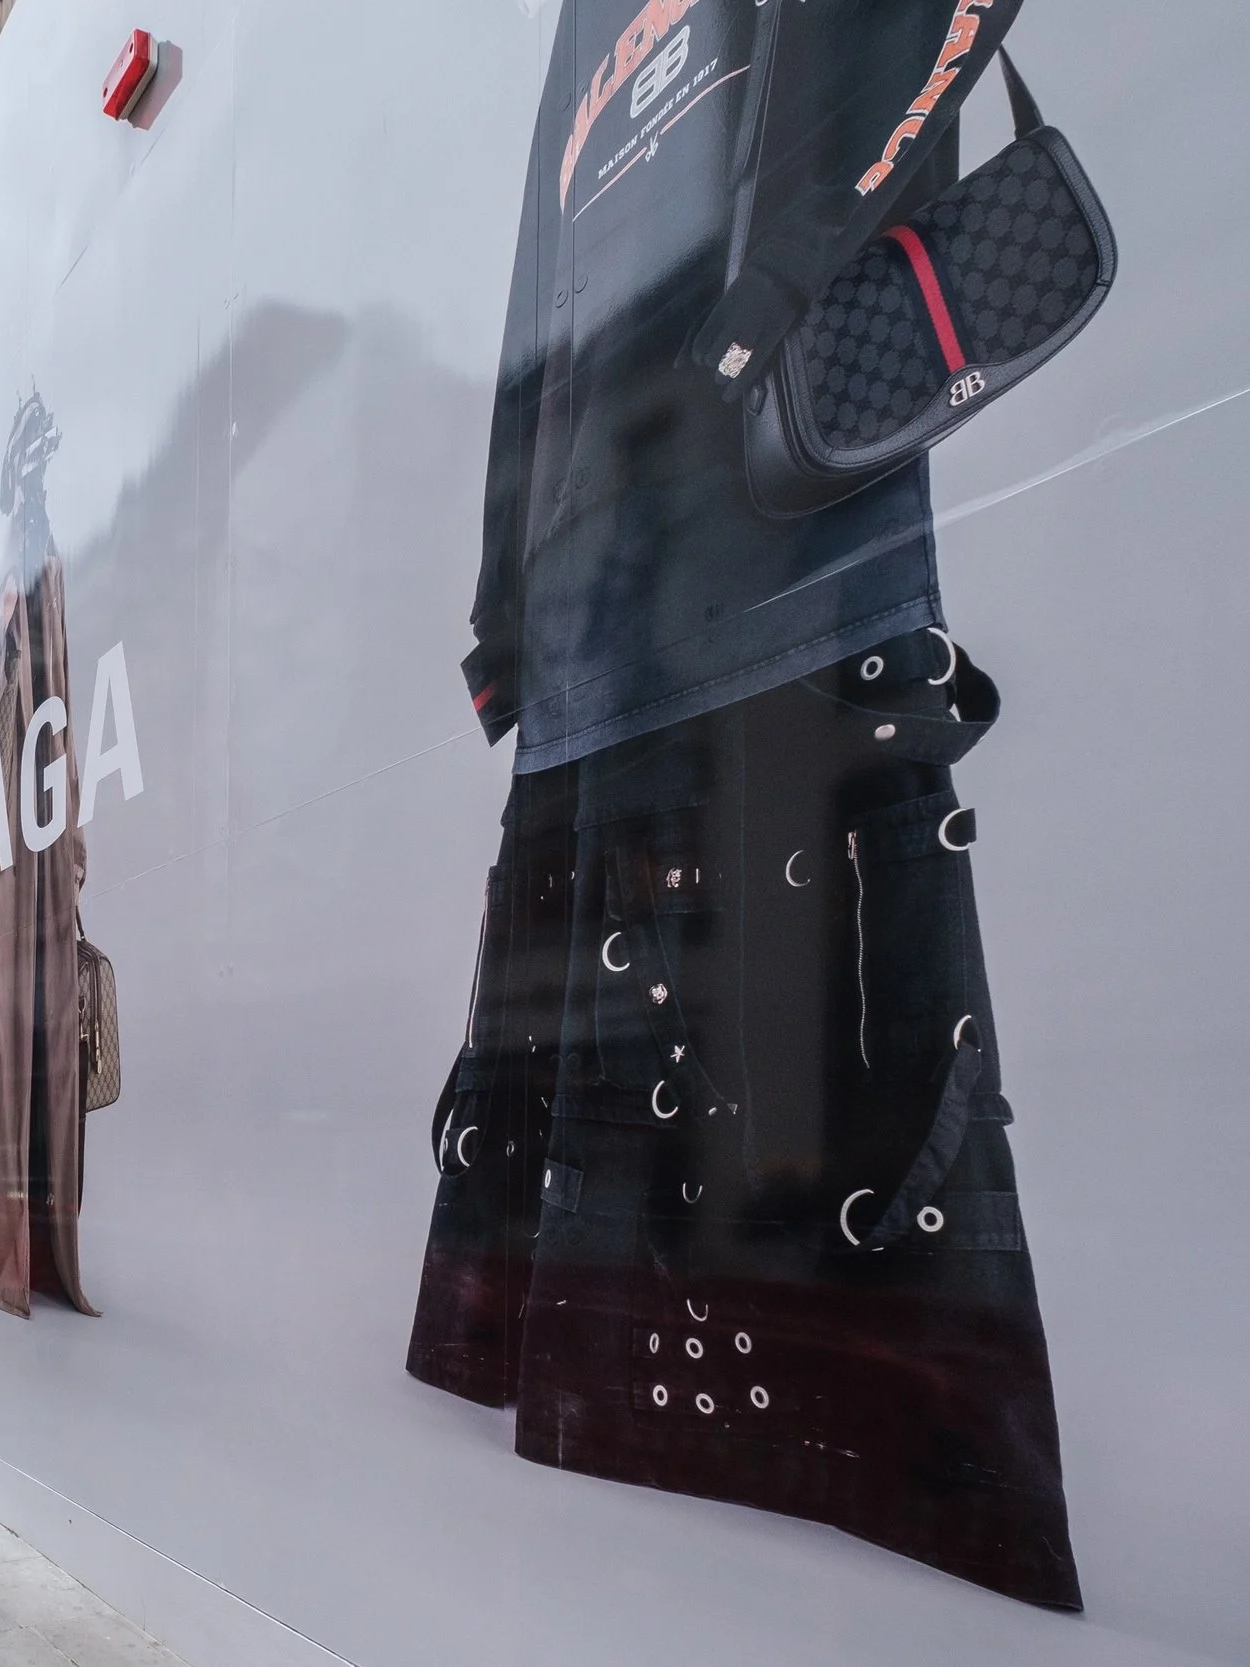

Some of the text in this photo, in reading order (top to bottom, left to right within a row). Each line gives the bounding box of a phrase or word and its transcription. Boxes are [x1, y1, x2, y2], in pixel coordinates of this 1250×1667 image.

[597, 134, 638, 180] MAISON
[674, 83, 691, 106] EN
[692, 57, 719, 88] 1917
